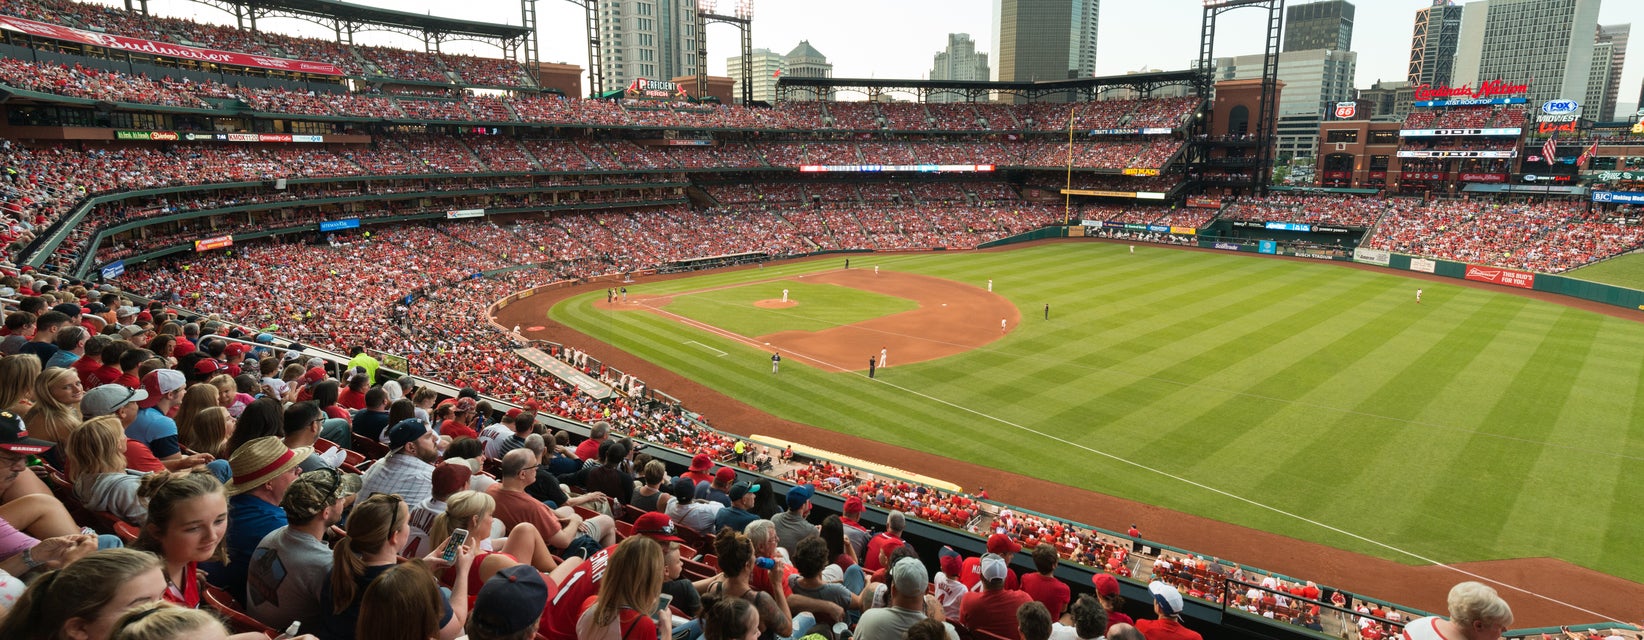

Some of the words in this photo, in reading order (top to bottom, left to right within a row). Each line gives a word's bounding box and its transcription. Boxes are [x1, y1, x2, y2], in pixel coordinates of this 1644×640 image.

[93, 32, 233, 62] Budweiser
[638, 78, 676, 91] PERFICIENT
[1471, 79, 1527, 99] Nation
[1337, 107, 1354, 116] 66
[1550, 102, 1570, 110] FOX
[1536, 114, 1580, 123] MIDWEST
[1502, 271, 1515, 279] THIS
[1515, 273, 1533, 281] BUD'S
[590, 549, 609, 584] SMITH
[552, 569, 586, 606] 1
